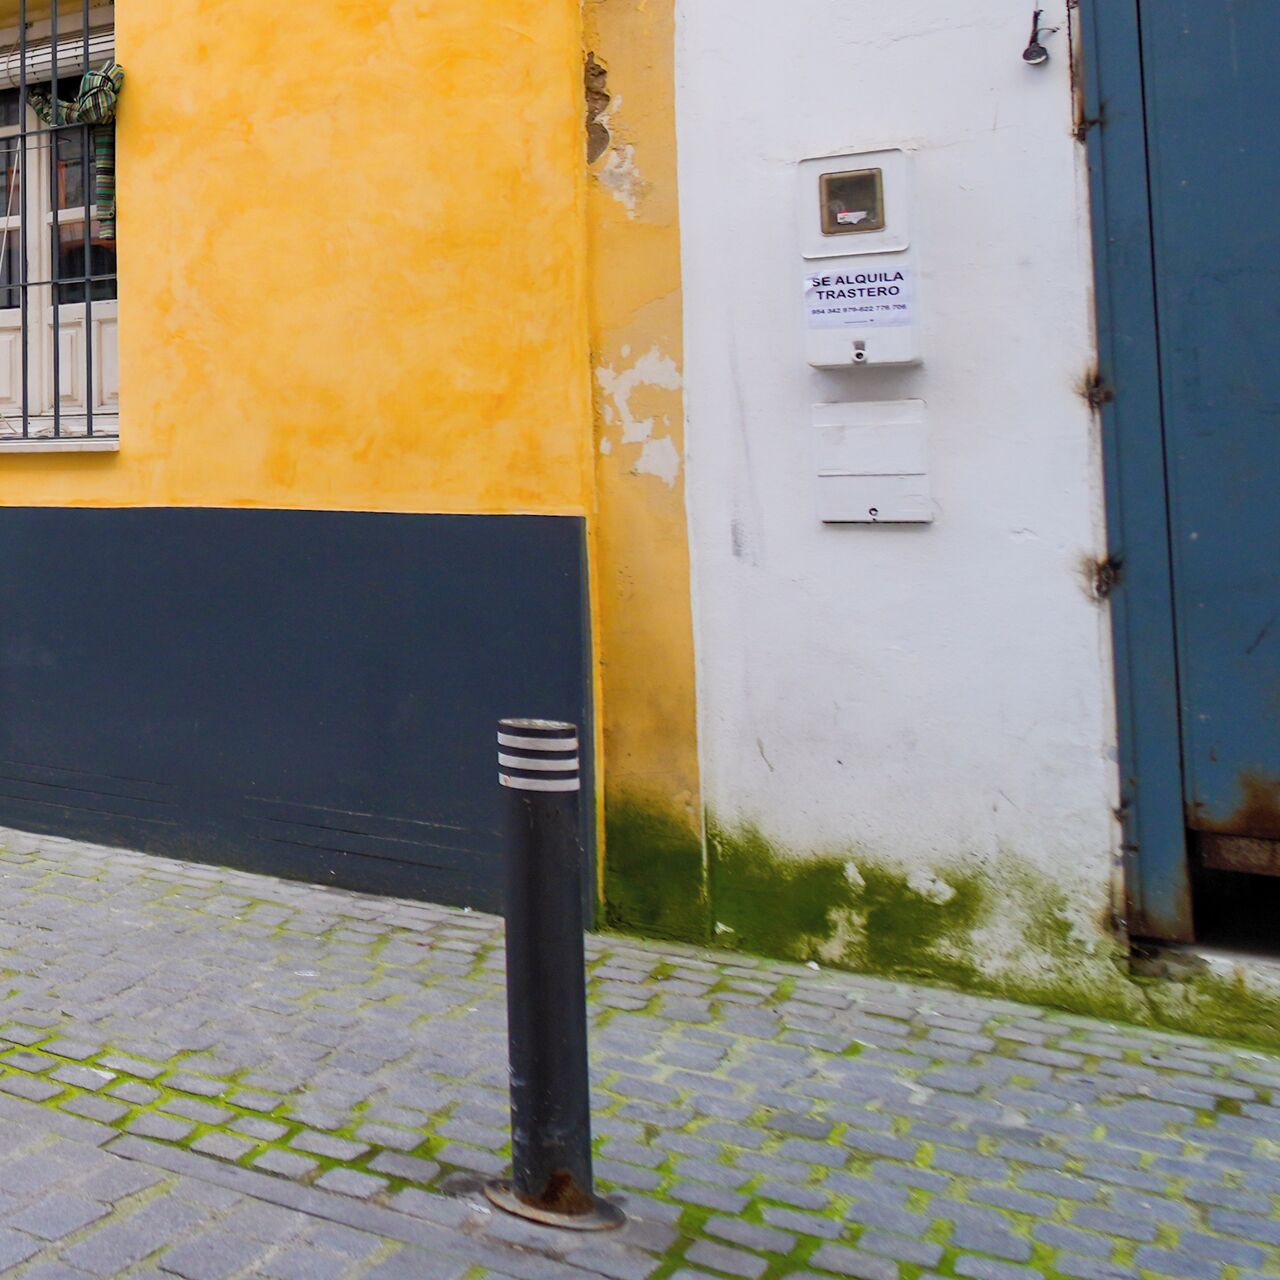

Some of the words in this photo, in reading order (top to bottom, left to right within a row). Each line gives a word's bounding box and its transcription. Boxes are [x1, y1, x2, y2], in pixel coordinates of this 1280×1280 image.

[812, 276, 831, 287] SE
[835, 271, 904, 285] ALQUILA
[816, 285, 900, 300] TRASTERO
